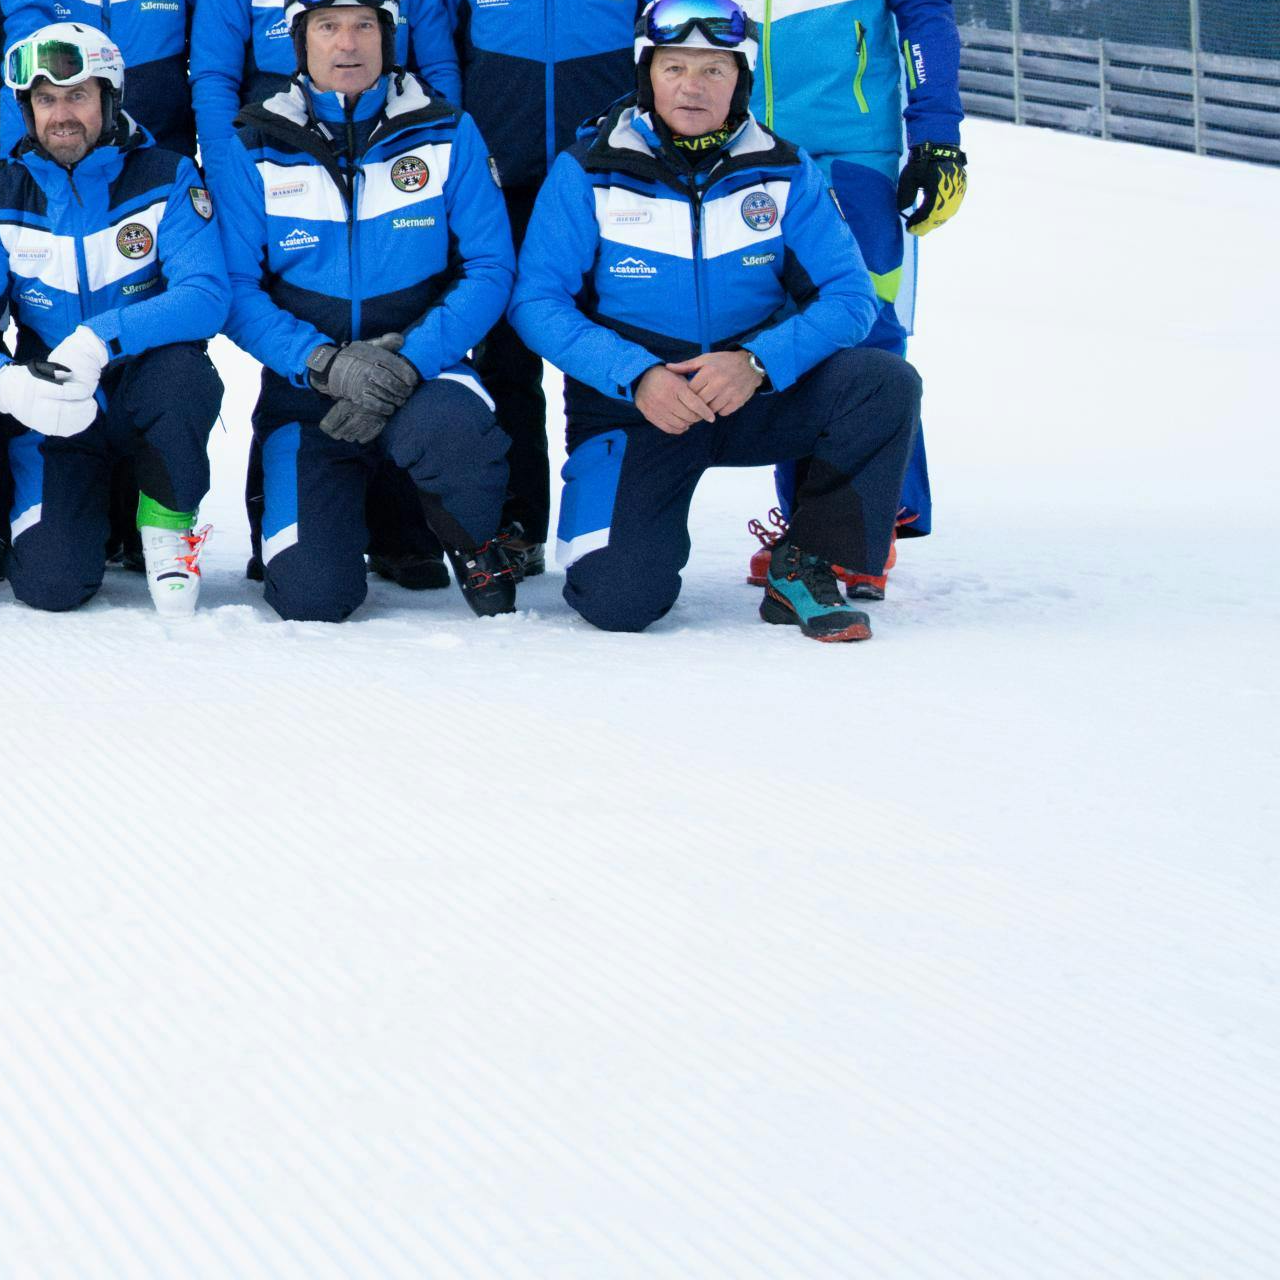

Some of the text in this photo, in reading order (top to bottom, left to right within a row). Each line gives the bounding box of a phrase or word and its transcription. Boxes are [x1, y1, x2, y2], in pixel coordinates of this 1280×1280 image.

[140, 1, 179, 11] S.Bernardo
[392, 217, 435, 228] S.Bernardo
[279, 235, 320, 247] s.caterina
[609, 264, 658, 275] s.caterina
